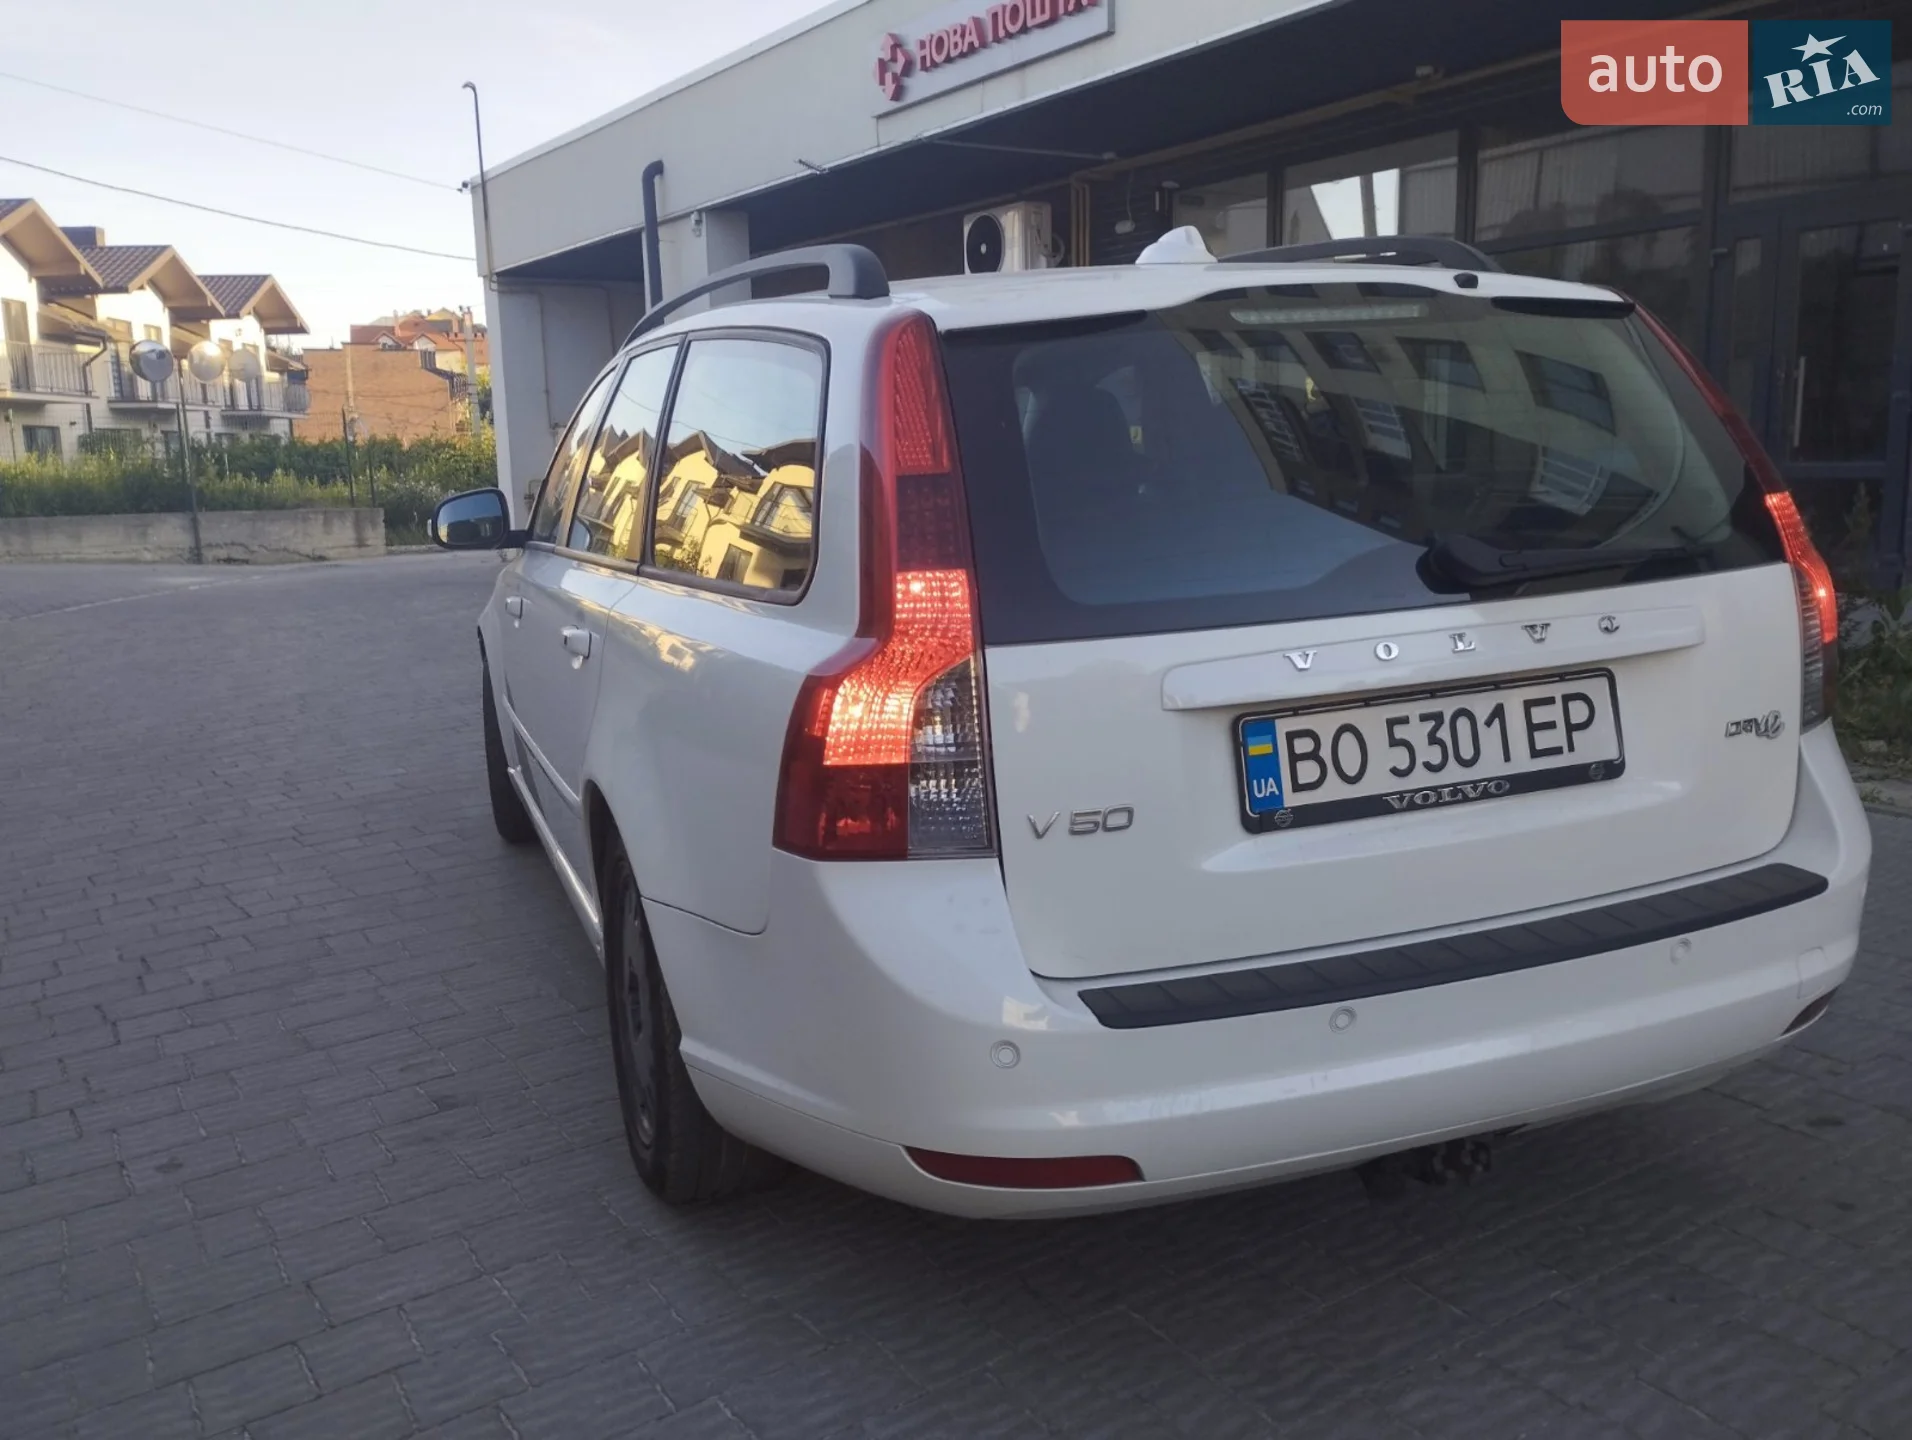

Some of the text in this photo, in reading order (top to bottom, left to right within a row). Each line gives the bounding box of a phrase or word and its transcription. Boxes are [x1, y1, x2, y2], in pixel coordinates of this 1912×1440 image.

[915, 16, 985, 72] НОВА
[1283, 614, 1621, 671] VOLVO
[1285, 691, 1596, 794] BO 5301 EP
[1253, 775, 1280, 799] UA
[1382, 779, 1511, 809] VOLVO
